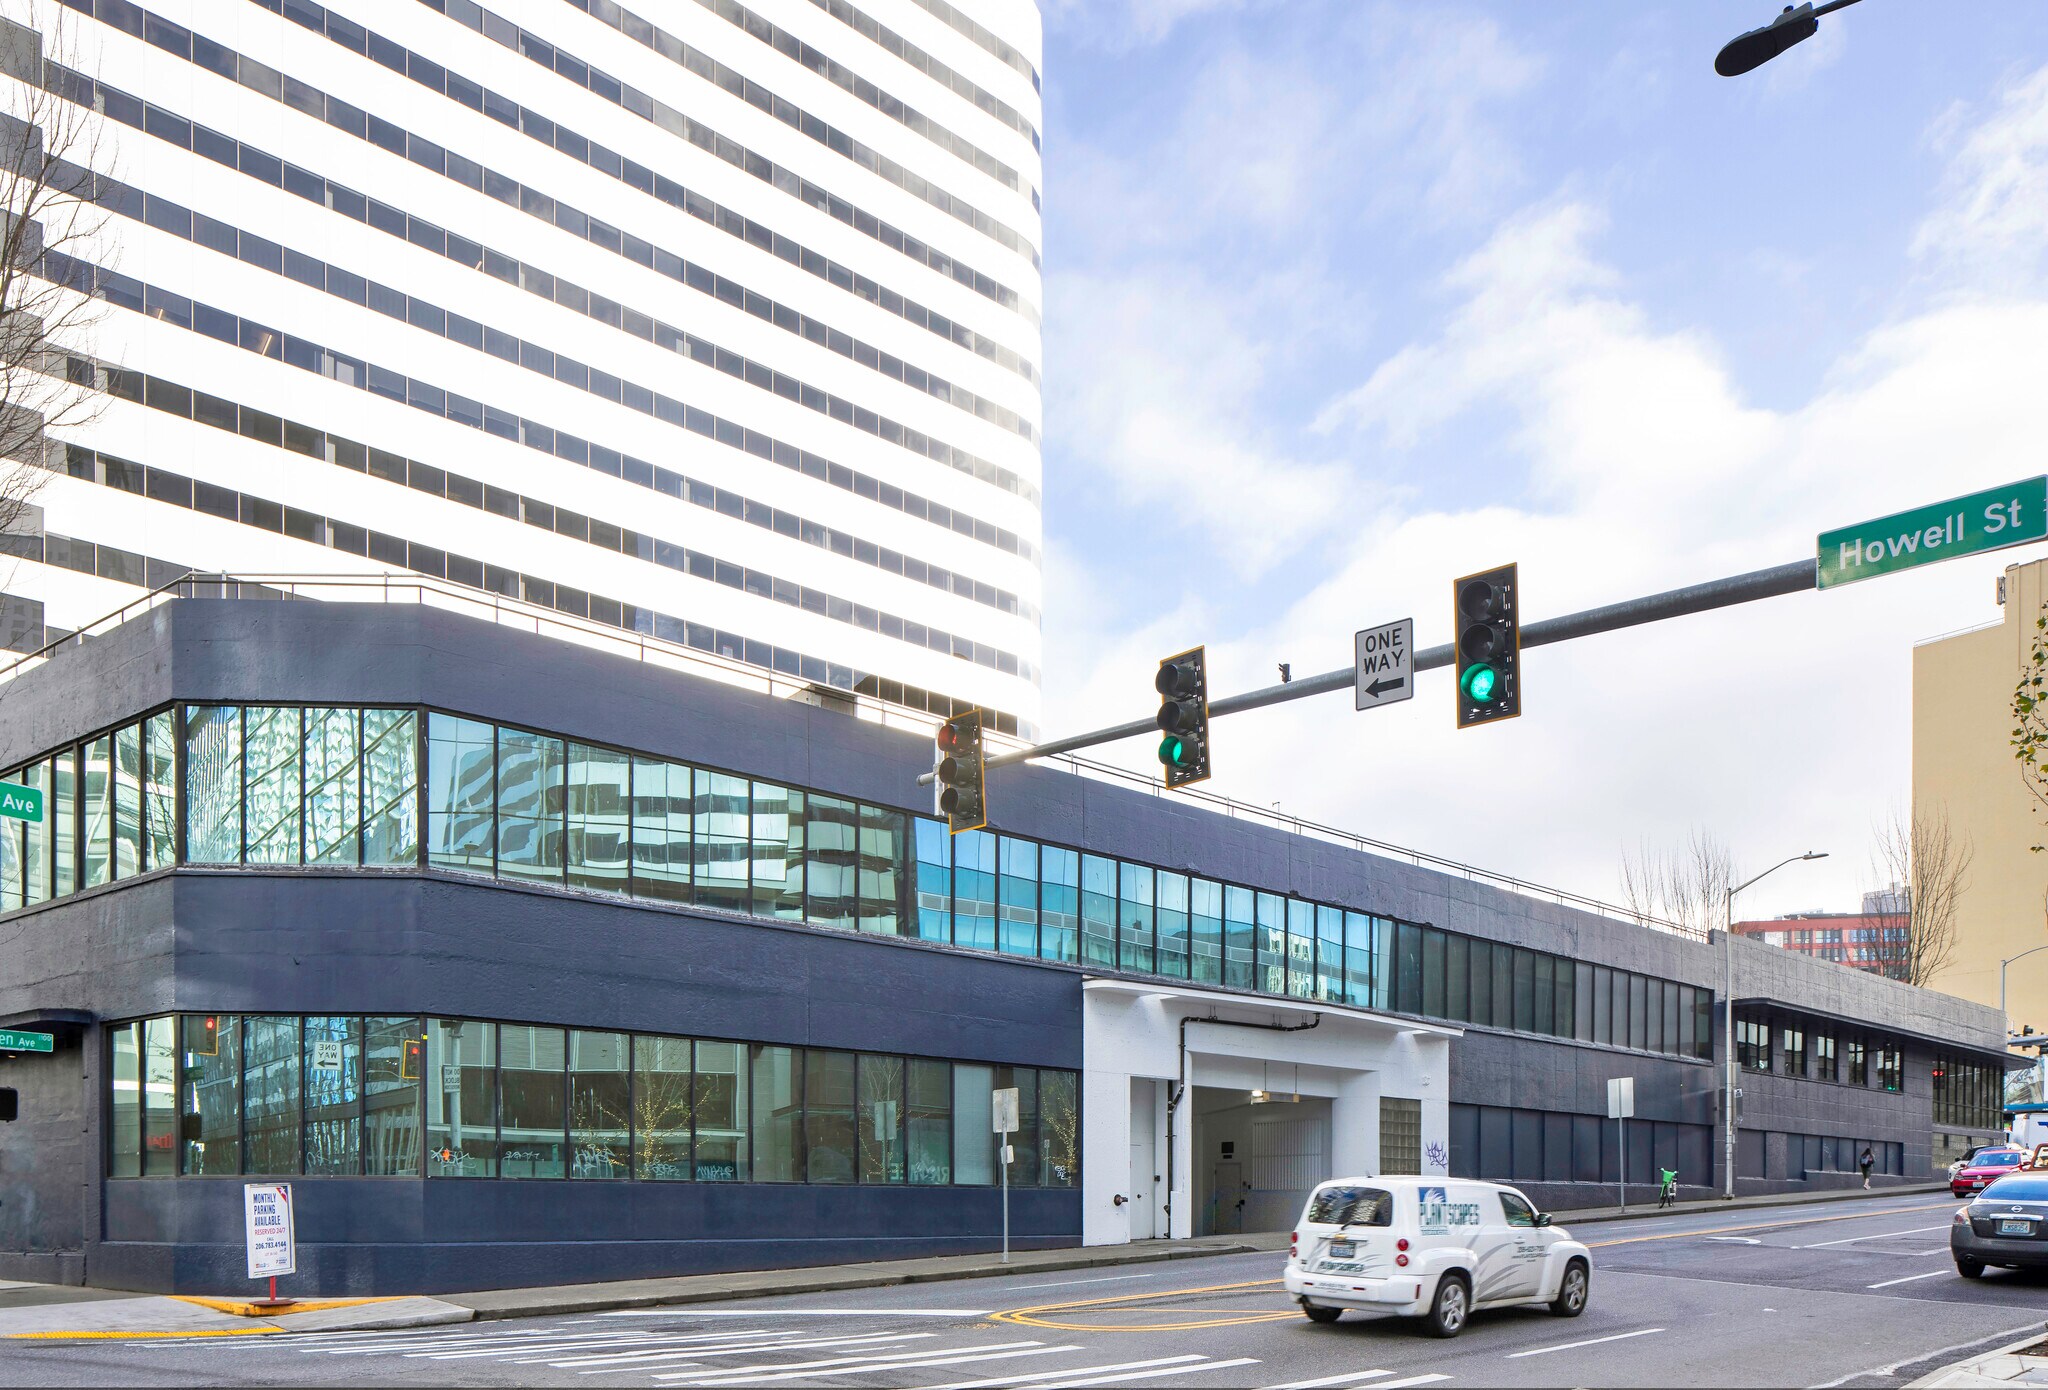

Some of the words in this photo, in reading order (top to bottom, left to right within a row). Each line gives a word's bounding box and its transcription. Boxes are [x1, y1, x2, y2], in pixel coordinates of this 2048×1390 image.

[1839, 512, 1964, 571] Howell
[1983, 498, 2022, 534] St
[1365, 627, 1403, 653] ONE
[1363, 648, 1404, 675] WAY
[2, 793, 35, 813] Ave
[18, 1037, 36, 1047] Ave
[253, 1193, 277, 1204] MONTHLY
[253, 1205, 275, 1215] PARKING
[1419, 1203, 1479, 1226] PLANTSCAPES
[254, 1216, 281, 1226] AVAILABLE
